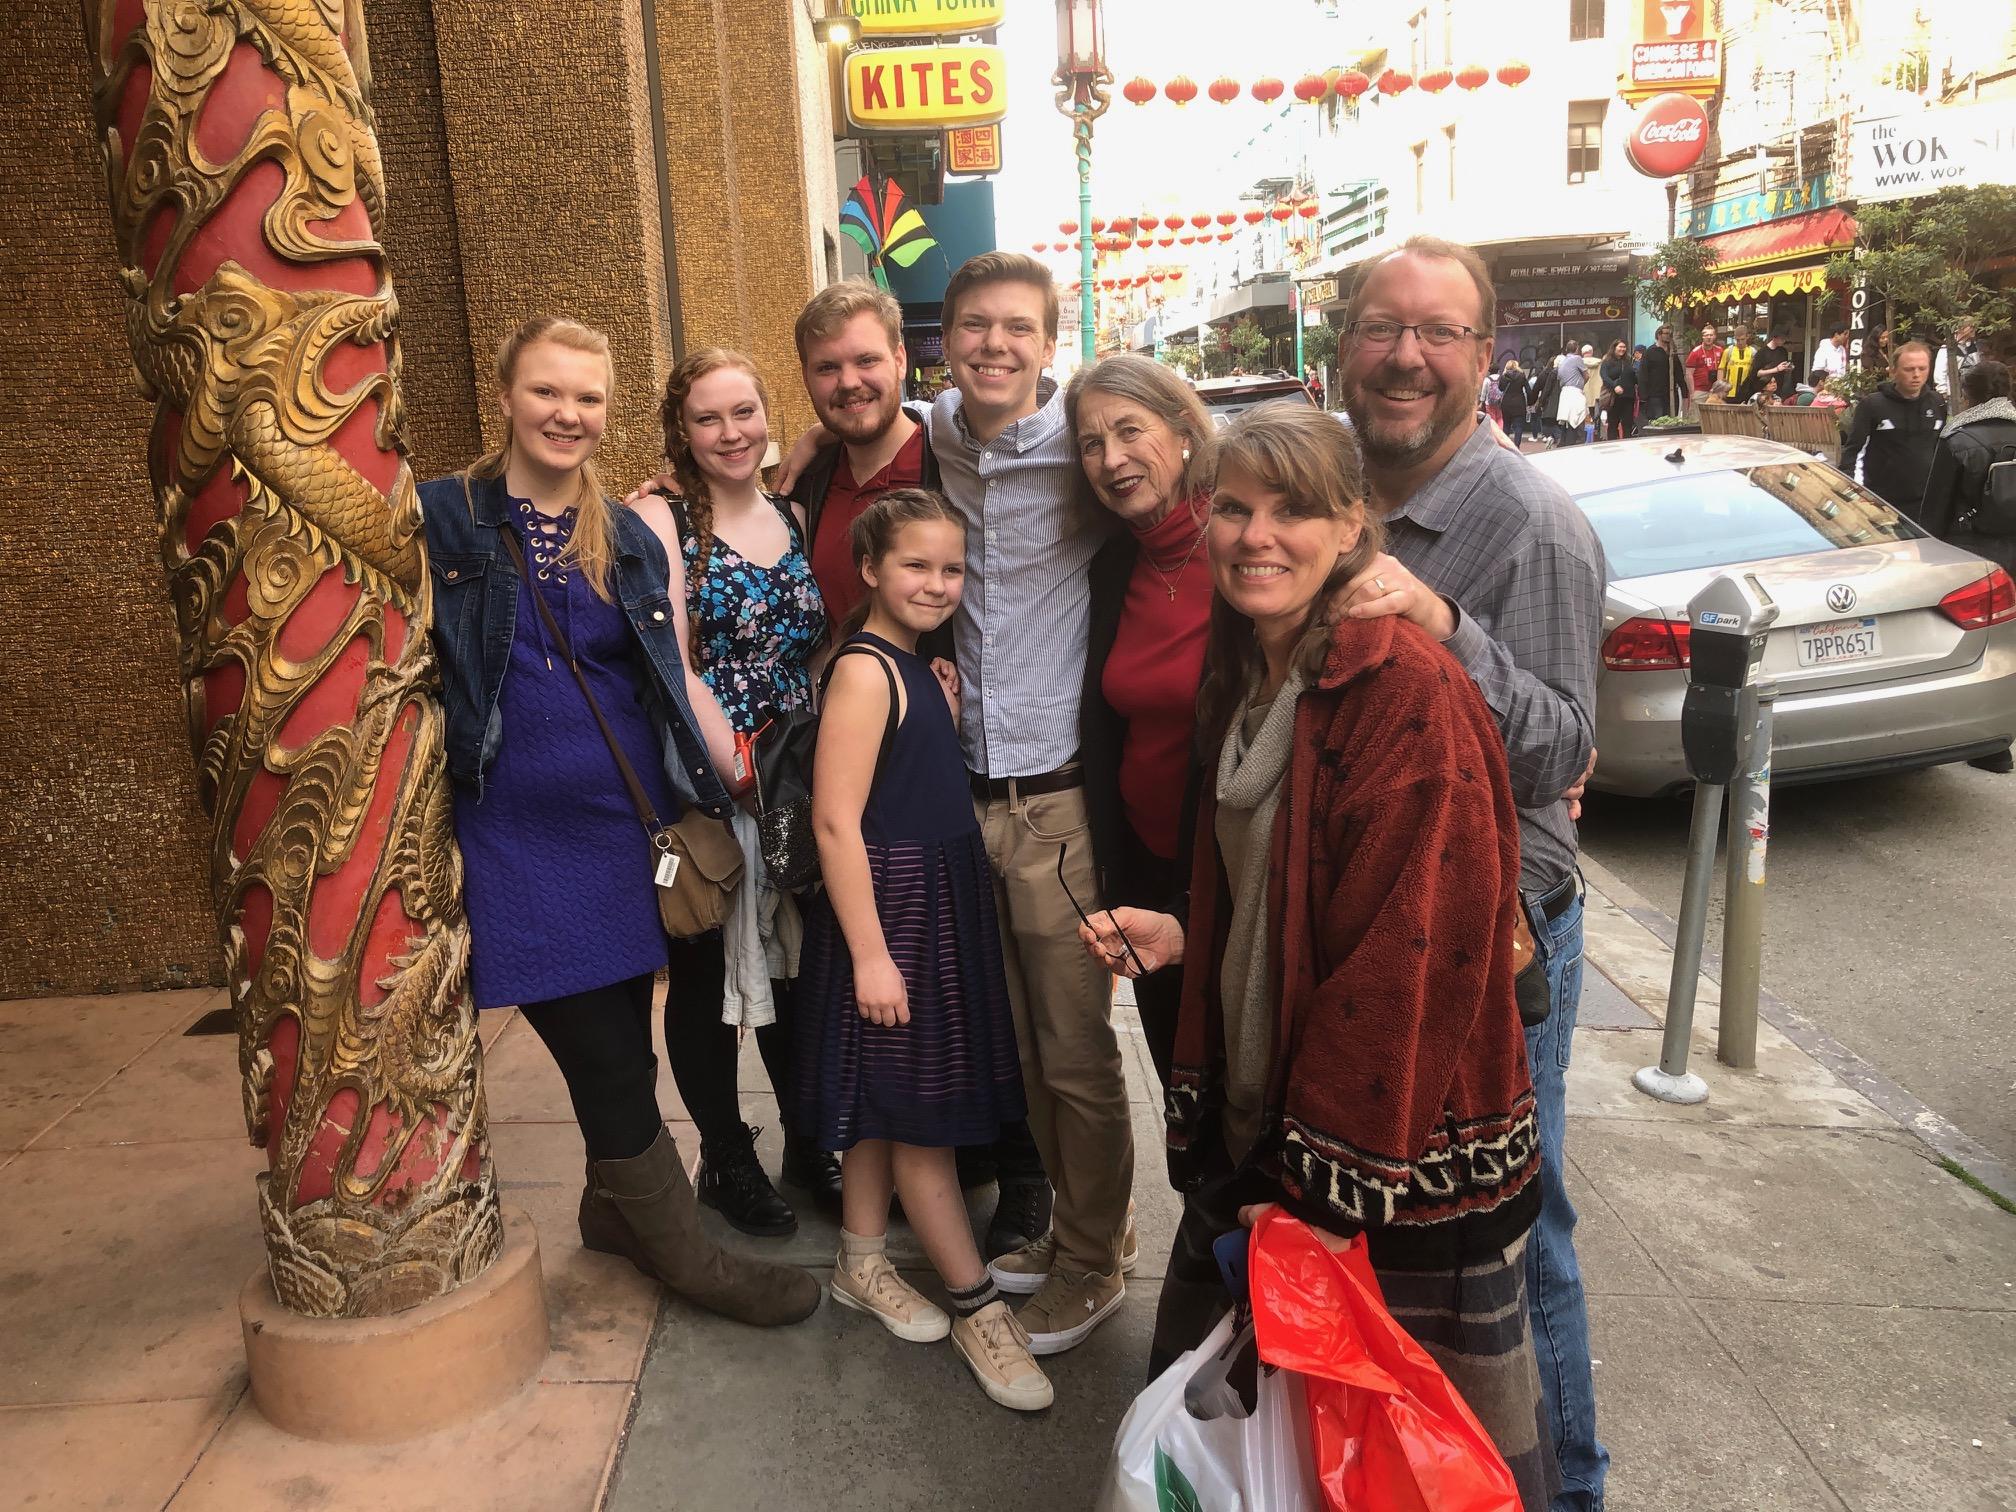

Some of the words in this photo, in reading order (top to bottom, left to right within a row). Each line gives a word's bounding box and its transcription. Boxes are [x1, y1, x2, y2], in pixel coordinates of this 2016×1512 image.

[861, 59, 993, 110] KITES
[1872, 124, 1896, 140] the
[1872, 137, 1948, 168] WOK
[1738, 276, 1774, 296] Bakery
[1792, 271, 1813, 288] 720
[1802, 631, 1874, 659] 7BPR657
